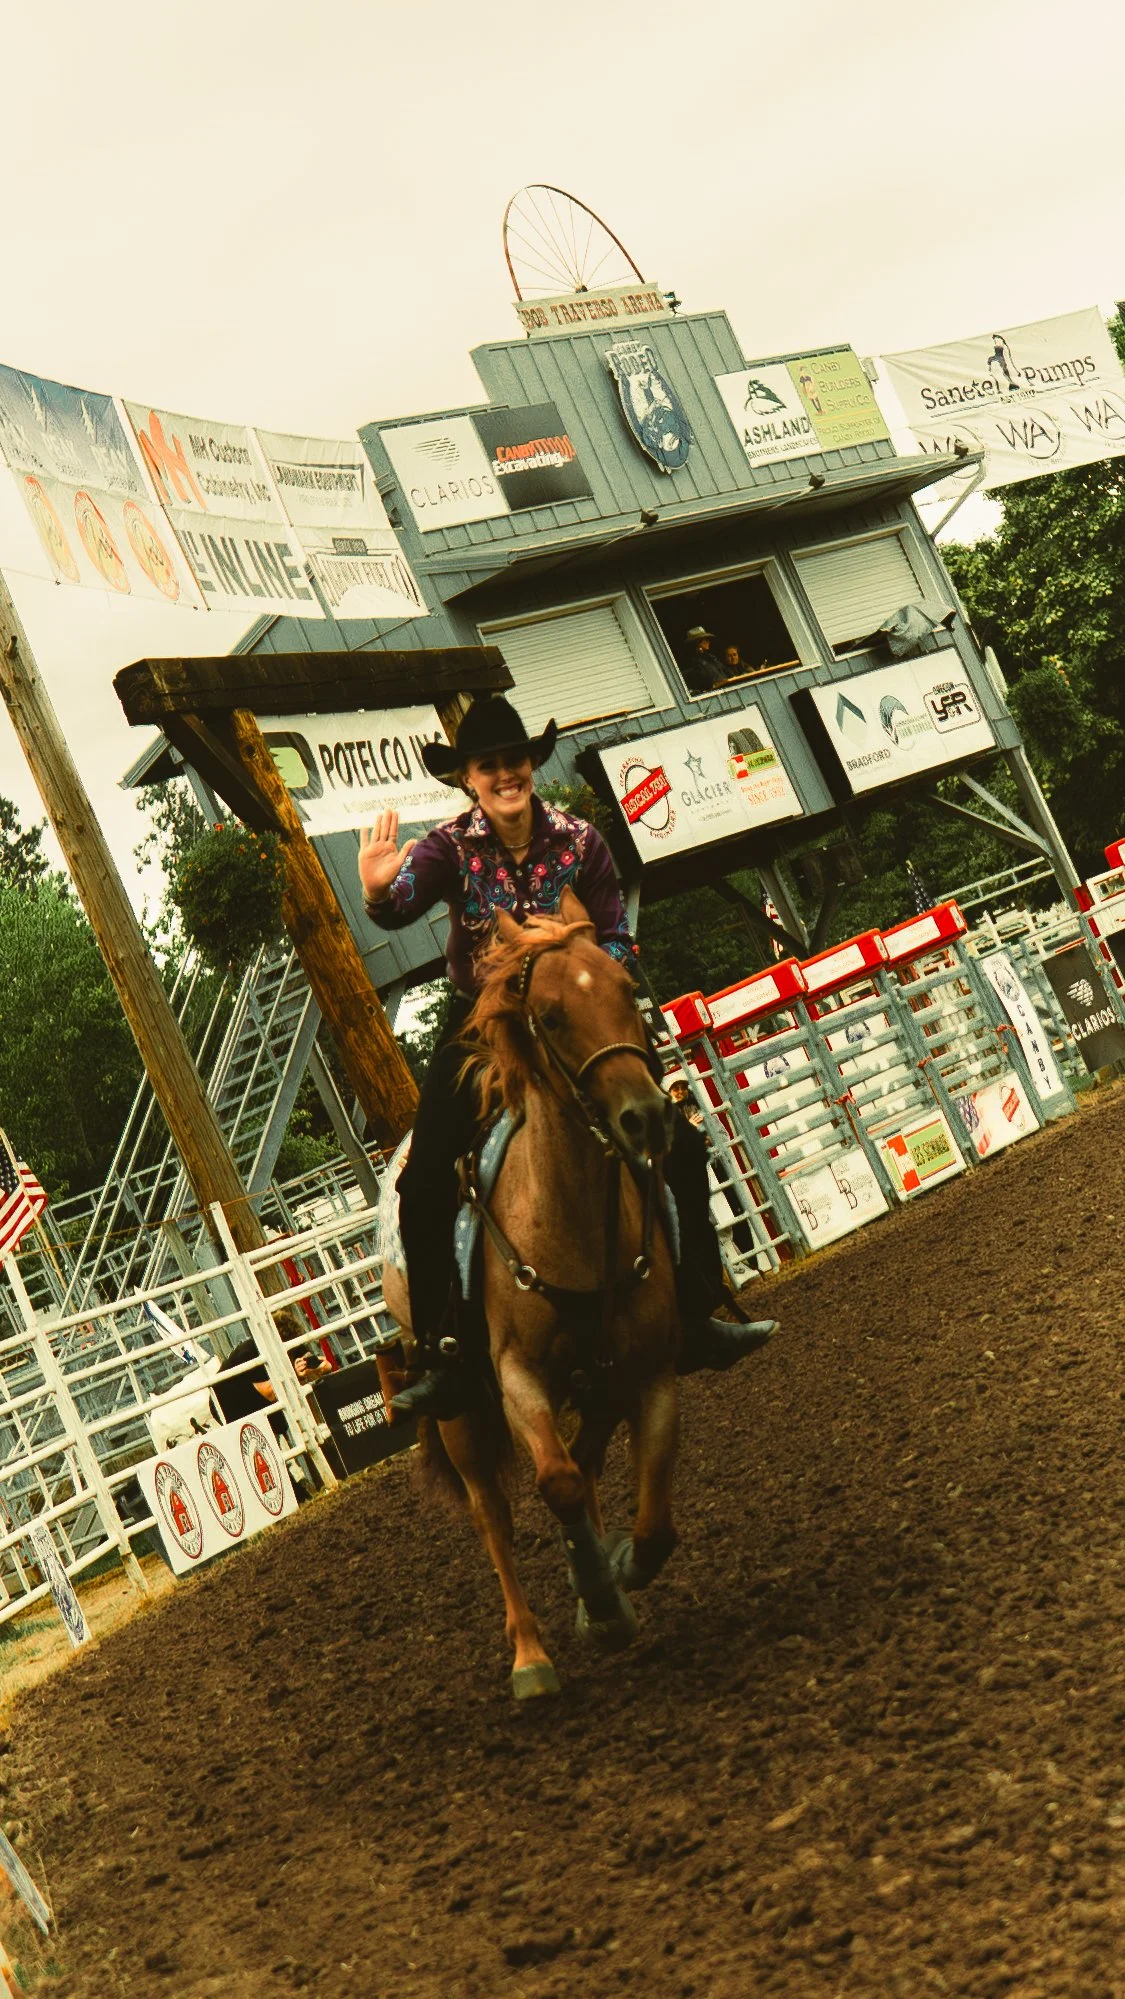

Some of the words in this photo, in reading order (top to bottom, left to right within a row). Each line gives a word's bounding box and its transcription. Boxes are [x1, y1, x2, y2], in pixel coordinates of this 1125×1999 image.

[521, 307, 549, 329] BOB
[550, 296, 619, 325] TRAVERSO
[620, 291, 664, 315] ARENA
[609, 347, 658, 377] RODEO
[1021, 355, 1096, 386] Pumps
[818, 376, 862, 394] BUILDERS
[744, 416, 812, 447] ASHLAND
[1069, 398, 1125, 432] WA
[995, 416, 1054, 450] WA
[208, 437, 252, 466] Custom
[410, 475, 495, 508] CLARIOS
[199, 533, 314, 601] INLINE
[318, 736, 412, 791] POTELCO
[846, 748, 892, 771] BRADFORD
[624, 785, 654, 816] LOCAL
[1071, 1006, 1116, 1041] CLARIOS
[1016, 1003, 1052, 1090] CANBY
